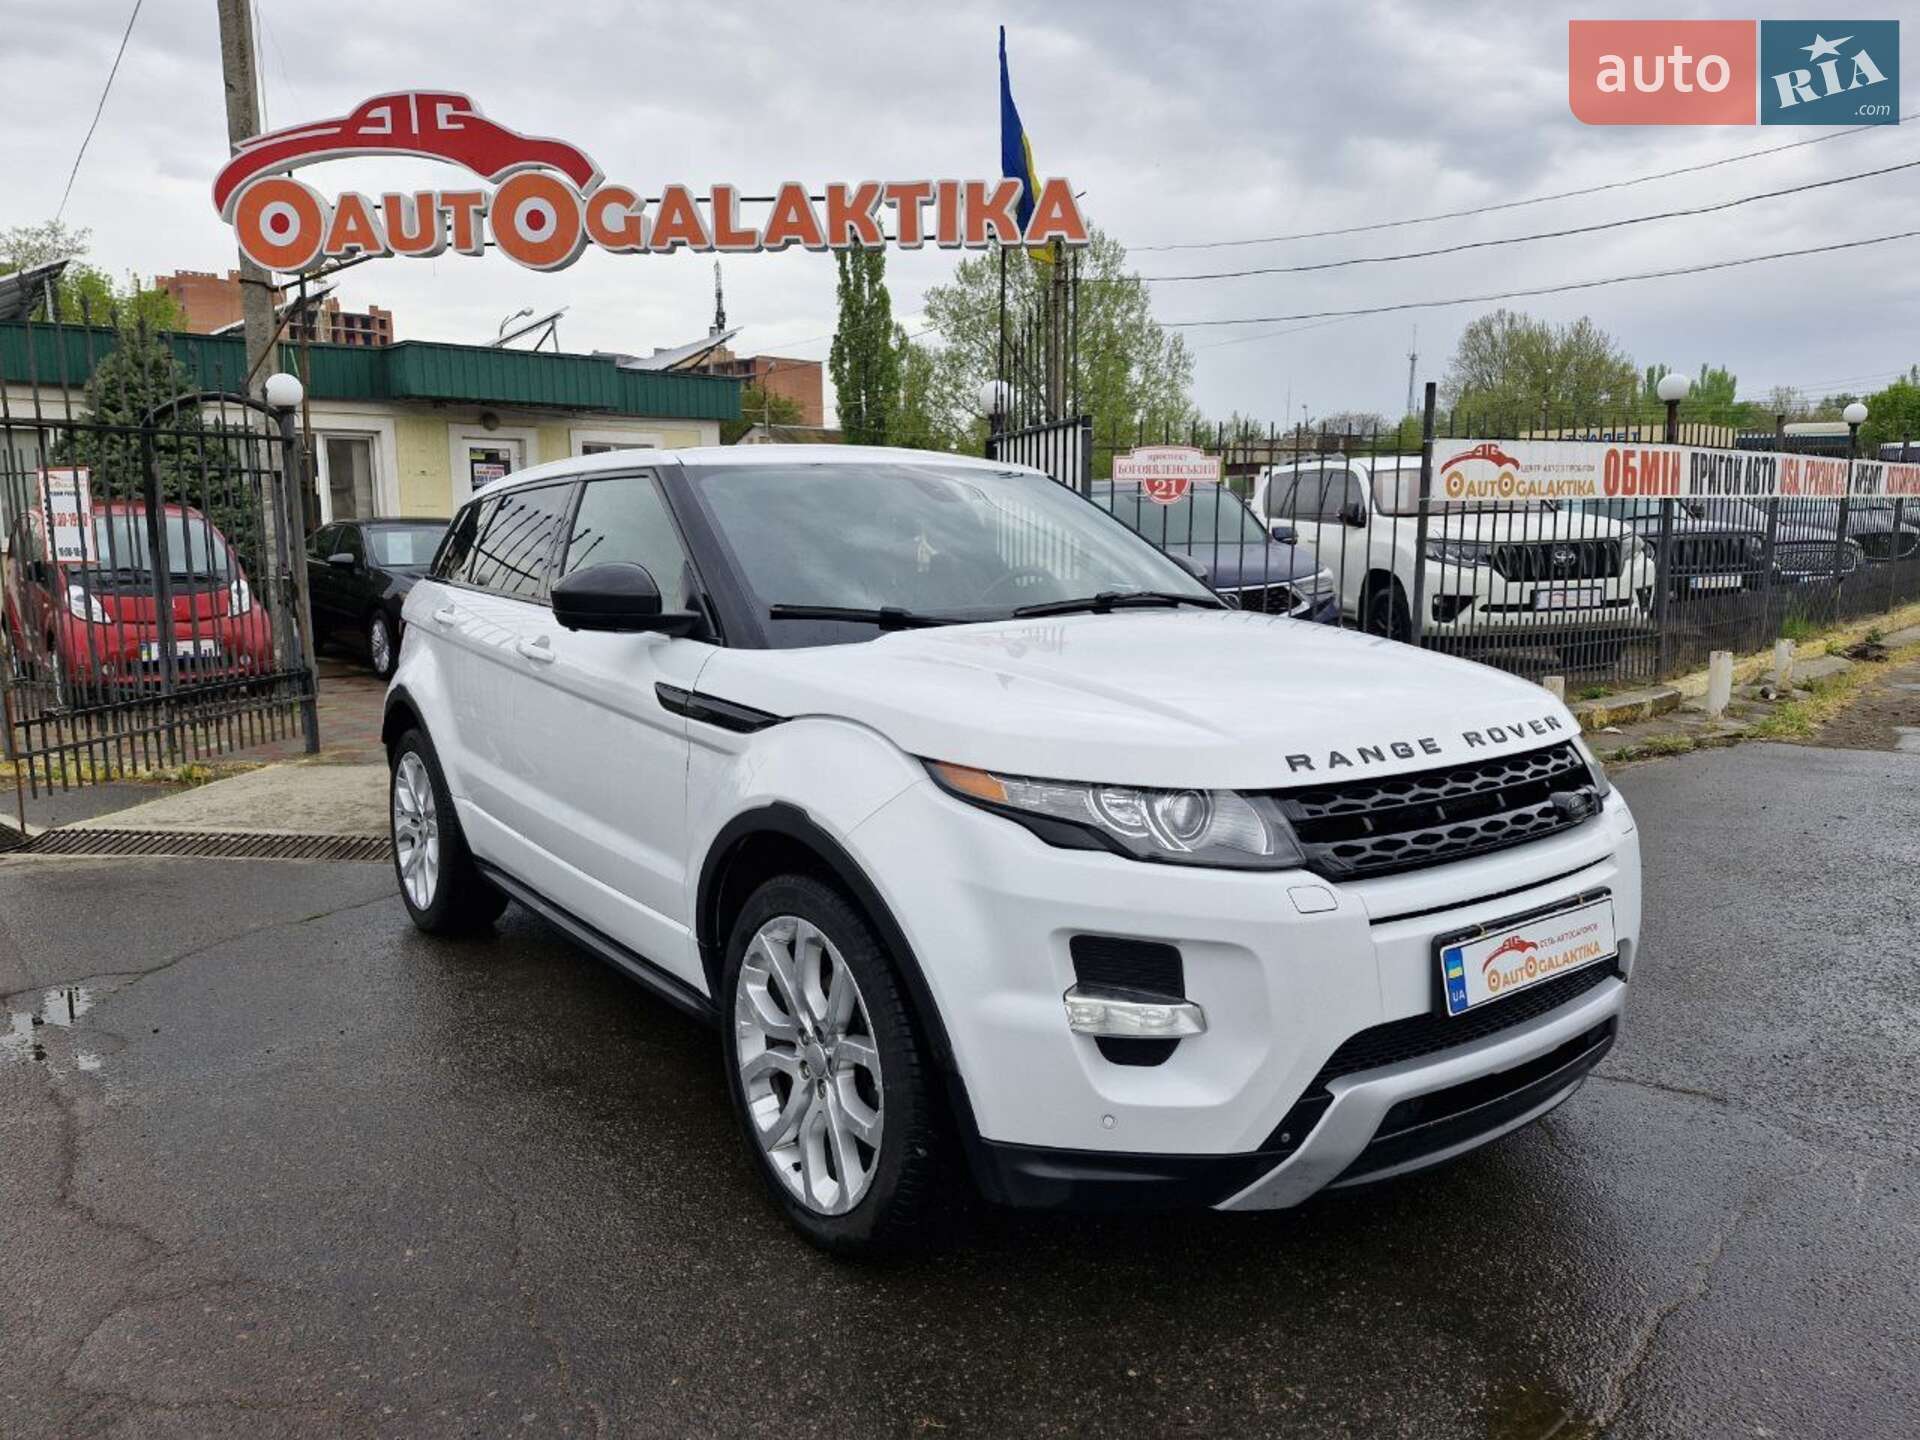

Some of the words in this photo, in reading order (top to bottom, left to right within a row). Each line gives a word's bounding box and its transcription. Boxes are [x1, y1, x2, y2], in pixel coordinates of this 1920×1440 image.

[1154, 479, 1178, 495] 21
[1603, 448, 1681, 496] ОБМІН
[1744, 455, 1776, 495] АВТО
[1285, 738, 1442, 772] RANGE
[1462, 715, 1563, 748] ROVER
[1452, 989, 1466, 1001] UA
